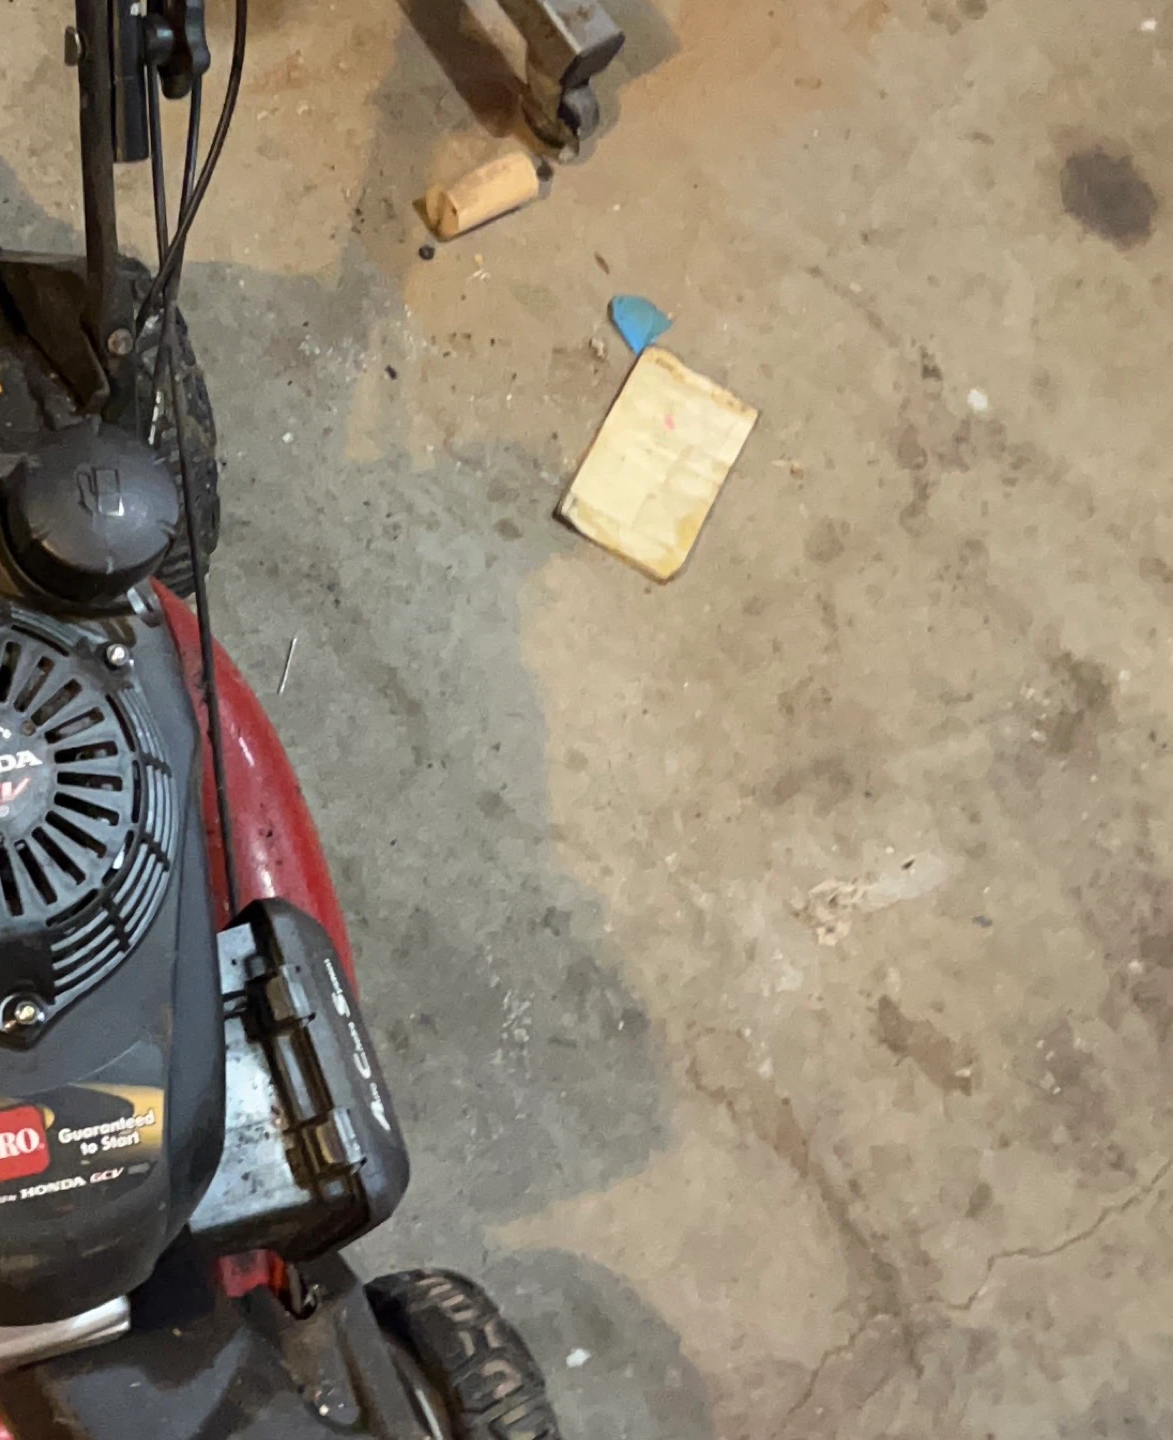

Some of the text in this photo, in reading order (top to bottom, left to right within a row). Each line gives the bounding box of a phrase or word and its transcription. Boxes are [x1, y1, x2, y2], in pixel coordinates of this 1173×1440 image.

[58, 1108, 155, 1143] Guaranteed
[80, 1131, 139, 1157] to Start
[20, 1176, 87, 1200] HONDA
[90, 1167, 124, 1184] GCV
